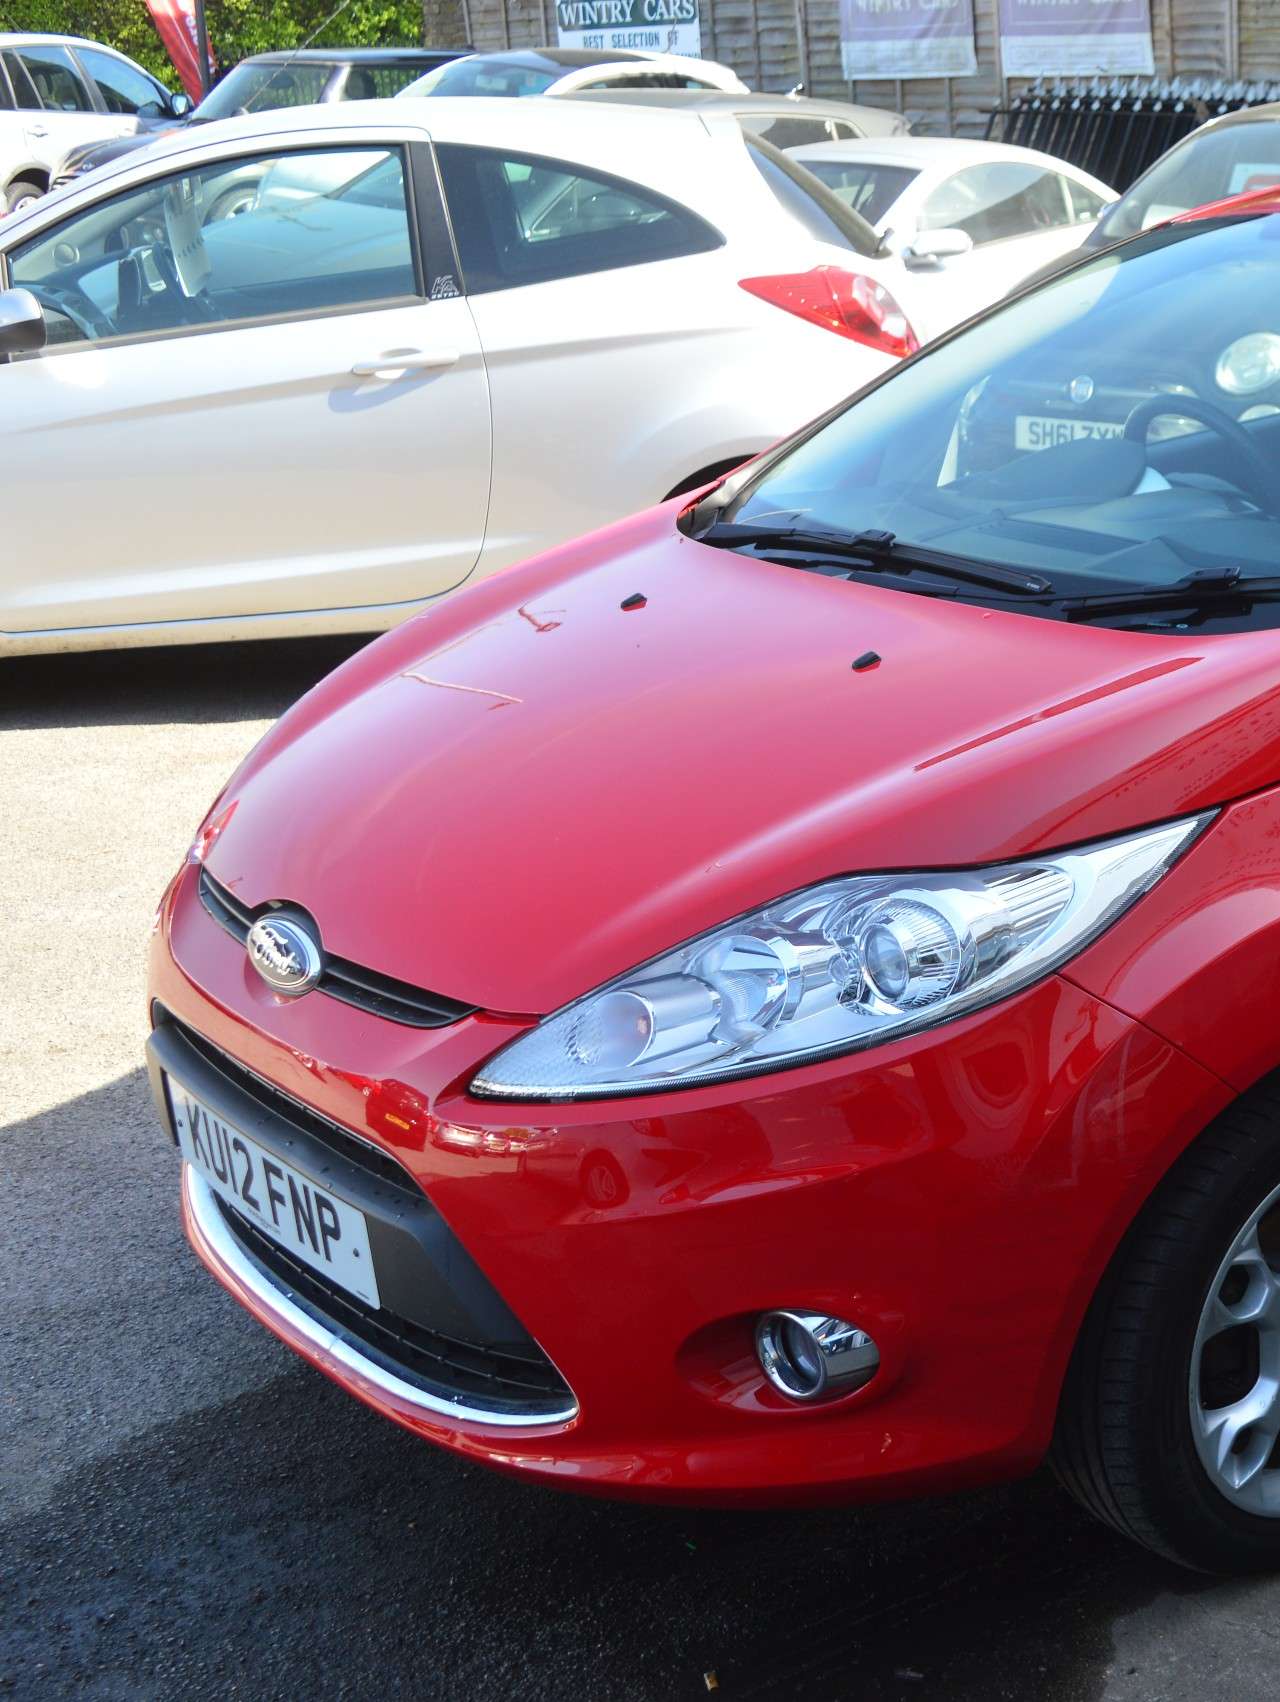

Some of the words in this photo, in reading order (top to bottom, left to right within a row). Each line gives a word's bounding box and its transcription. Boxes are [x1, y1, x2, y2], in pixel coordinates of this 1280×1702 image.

[560, 0, 634, 27] WINTRY
[645, 0, 694, 20] CARS
[583, 34, 604, 49] BEST
[612, 31, 660, 48] SELECTION
